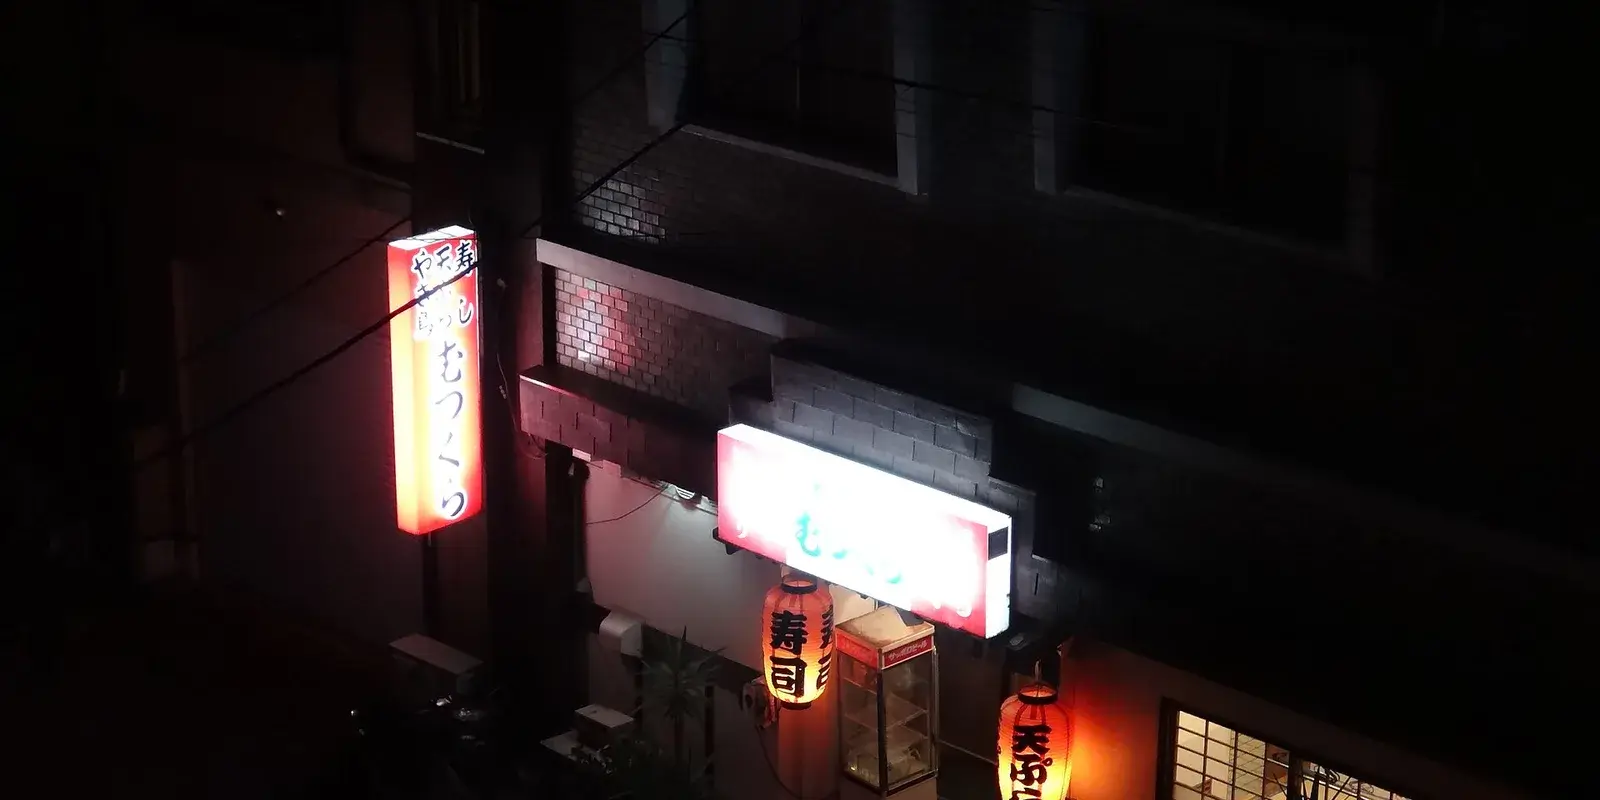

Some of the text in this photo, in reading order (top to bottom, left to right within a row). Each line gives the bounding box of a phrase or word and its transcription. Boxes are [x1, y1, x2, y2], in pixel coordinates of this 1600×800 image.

[435, 340, 465, 517] むつくら
[770, 610, 809, 697] 寿司
